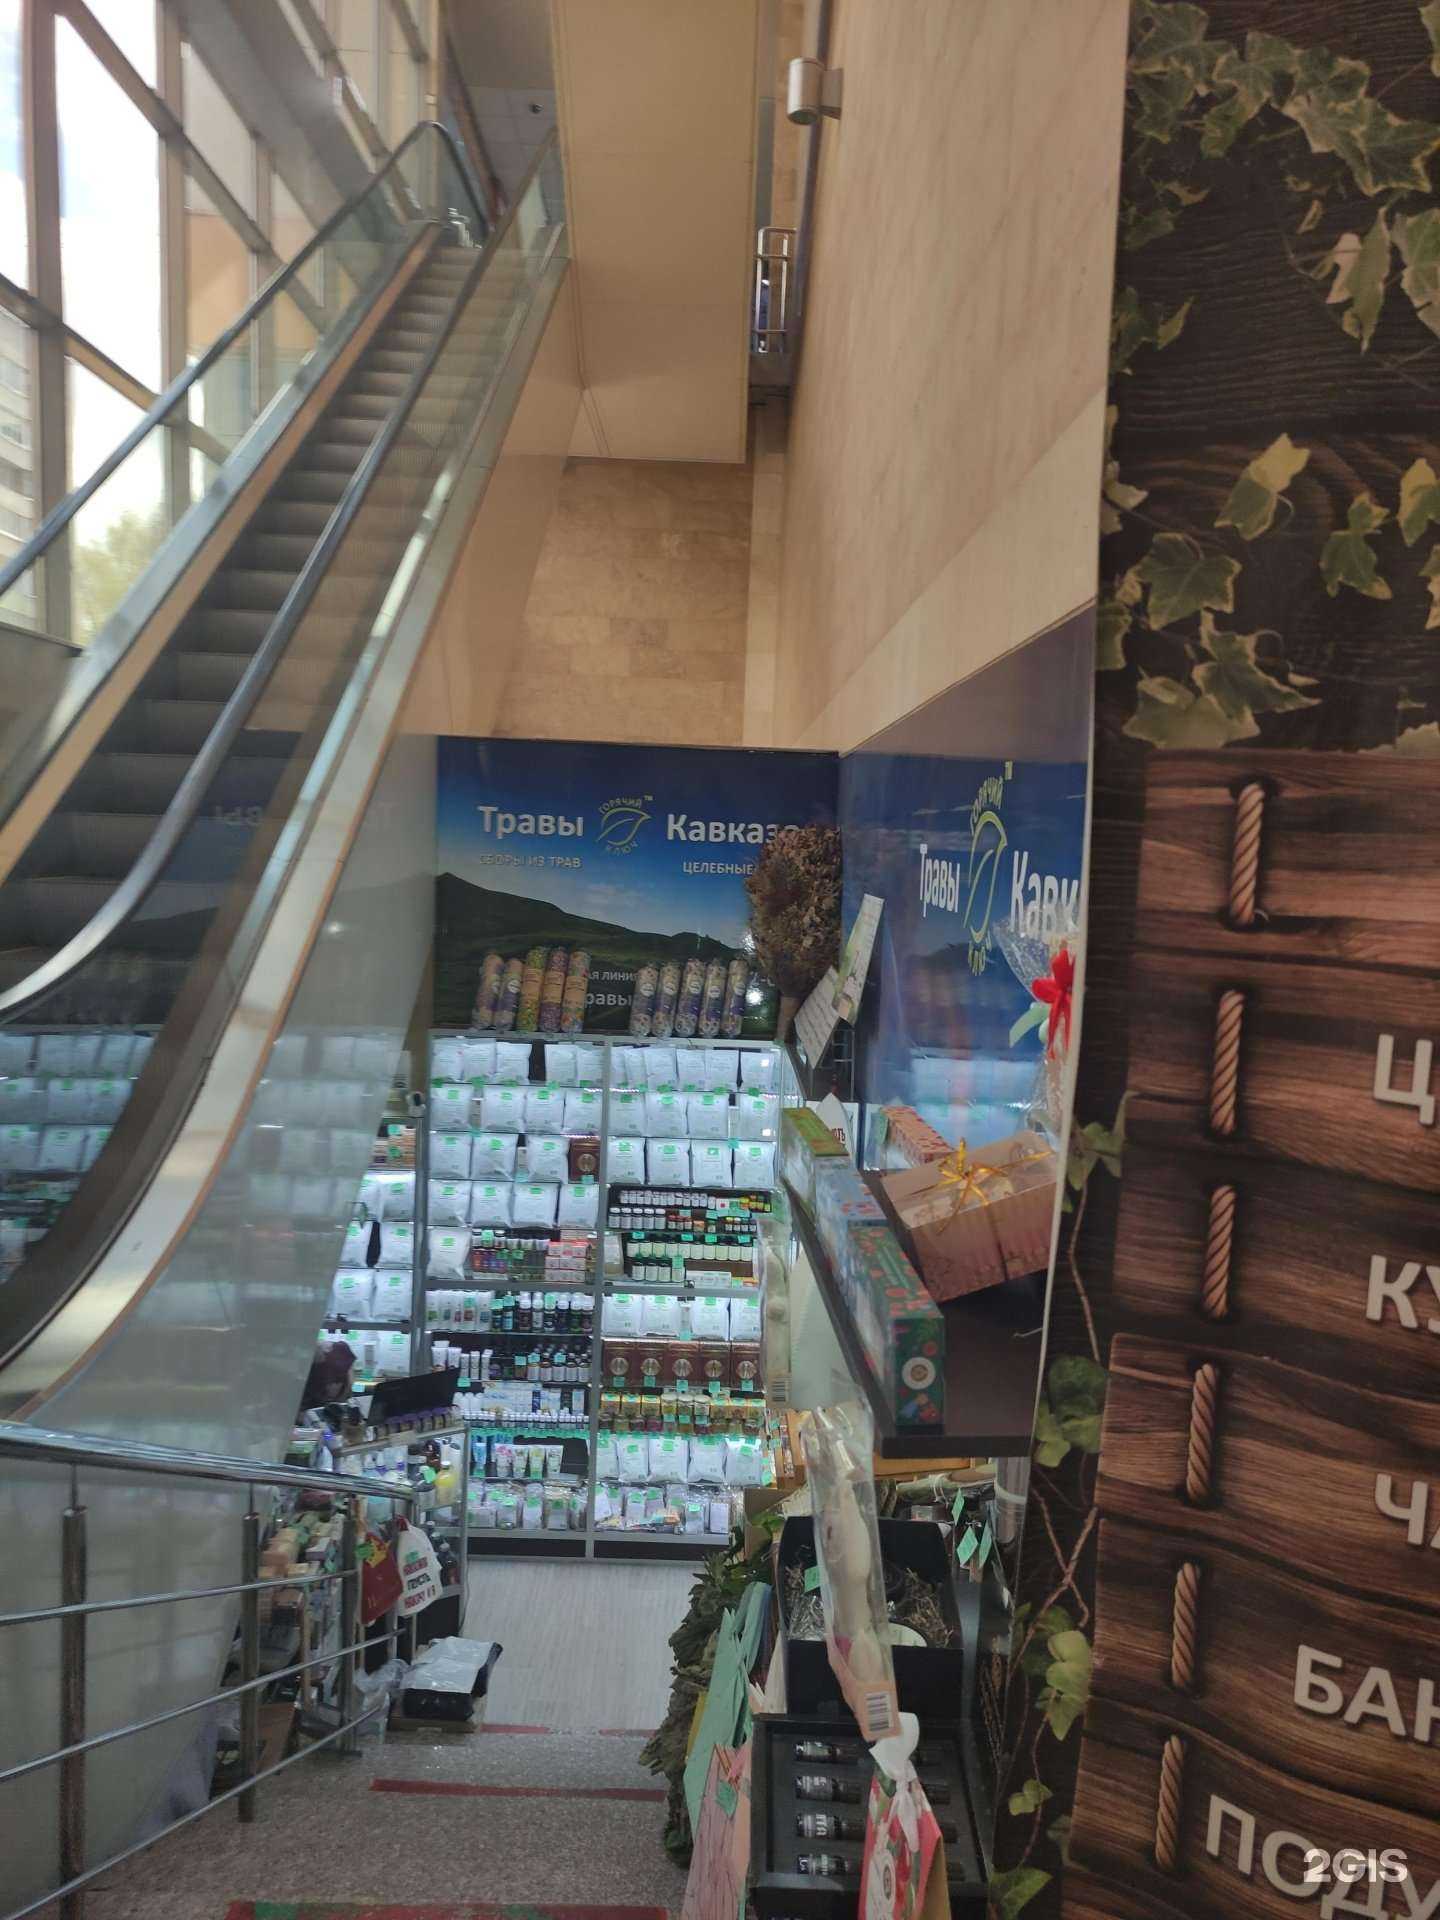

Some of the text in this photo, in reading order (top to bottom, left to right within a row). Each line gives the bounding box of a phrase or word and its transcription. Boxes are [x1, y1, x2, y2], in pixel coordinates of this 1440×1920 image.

[478, 806, 583, 840] Травы
[547, 856, 582, 869] ТРАВ
[682, 861, 754, 876] ЦЕЛЕБНЫЕ
[919, 843, 960, 918] Травы
[1373, 1033, 1435, 1125] Ц
[1365, 1254, 1440, 1334] К
[1374, 1473, 1440, 1549] Ч
